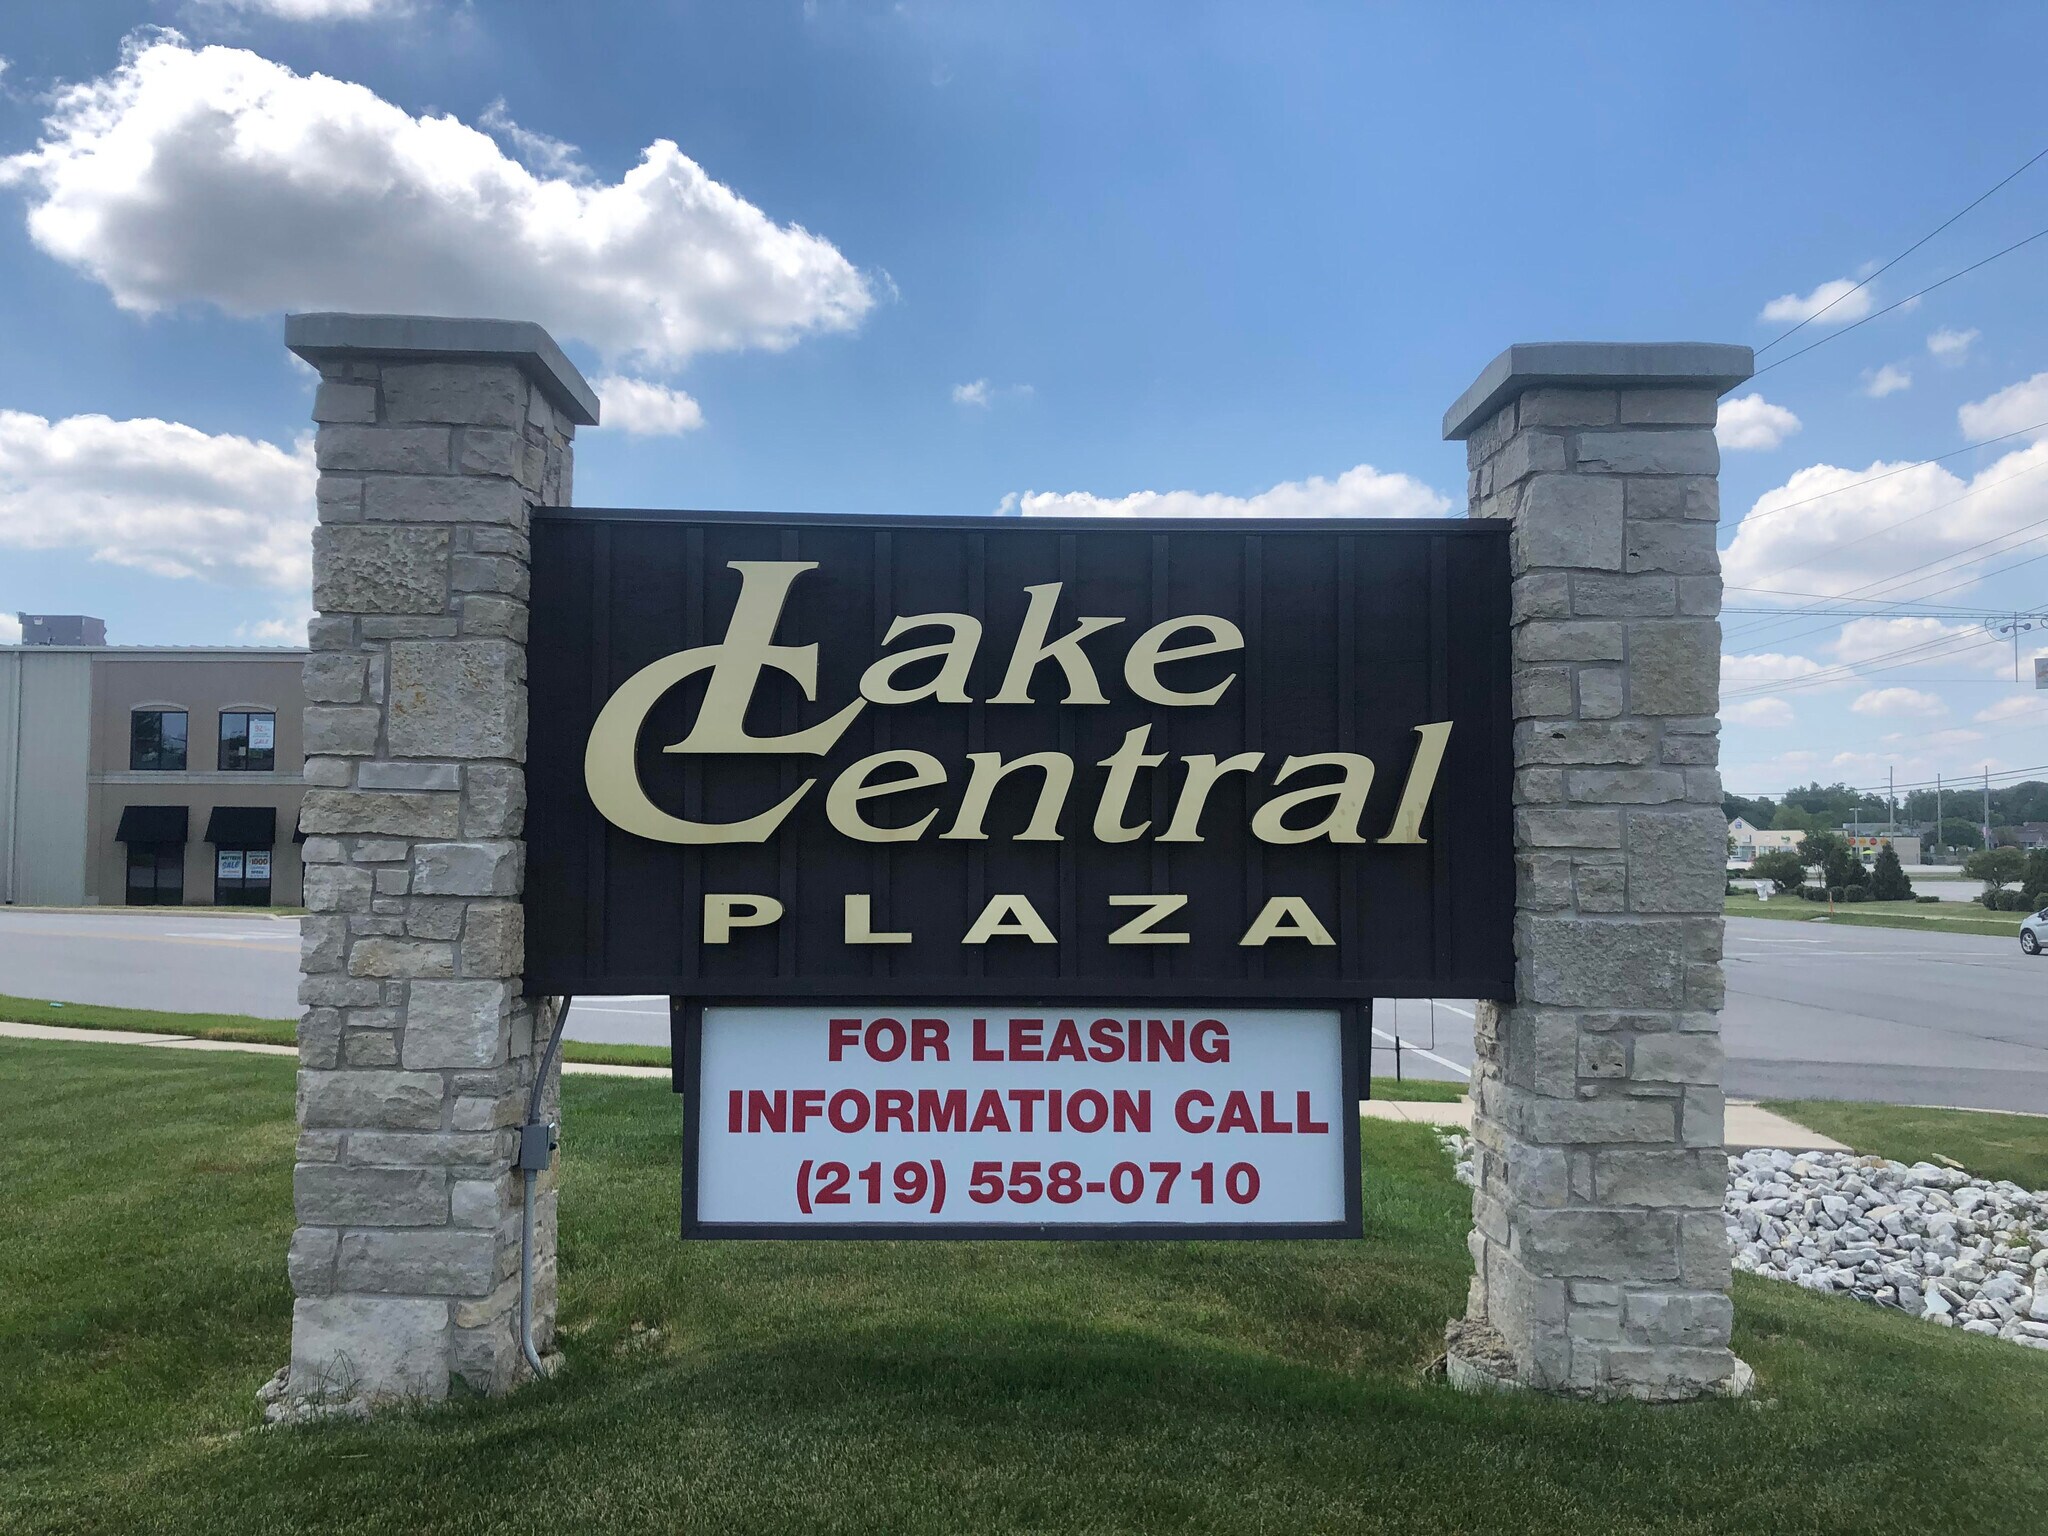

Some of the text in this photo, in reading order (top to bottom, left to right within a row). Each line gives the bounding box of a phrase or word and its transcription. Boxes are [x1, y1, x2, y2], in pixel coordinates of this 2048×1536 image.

[664, 560, 1246, 756] Lake
[584, 642, 1454, 846] Central
[703, 893, 1338, 946] PLAZA
[828, 1018, 1231, 1063] FOR LEASING
[729, 1088, 1329, 1134] INFORMATION CALL
[796, 1159, 1261, 1214] (219) 558-0710
